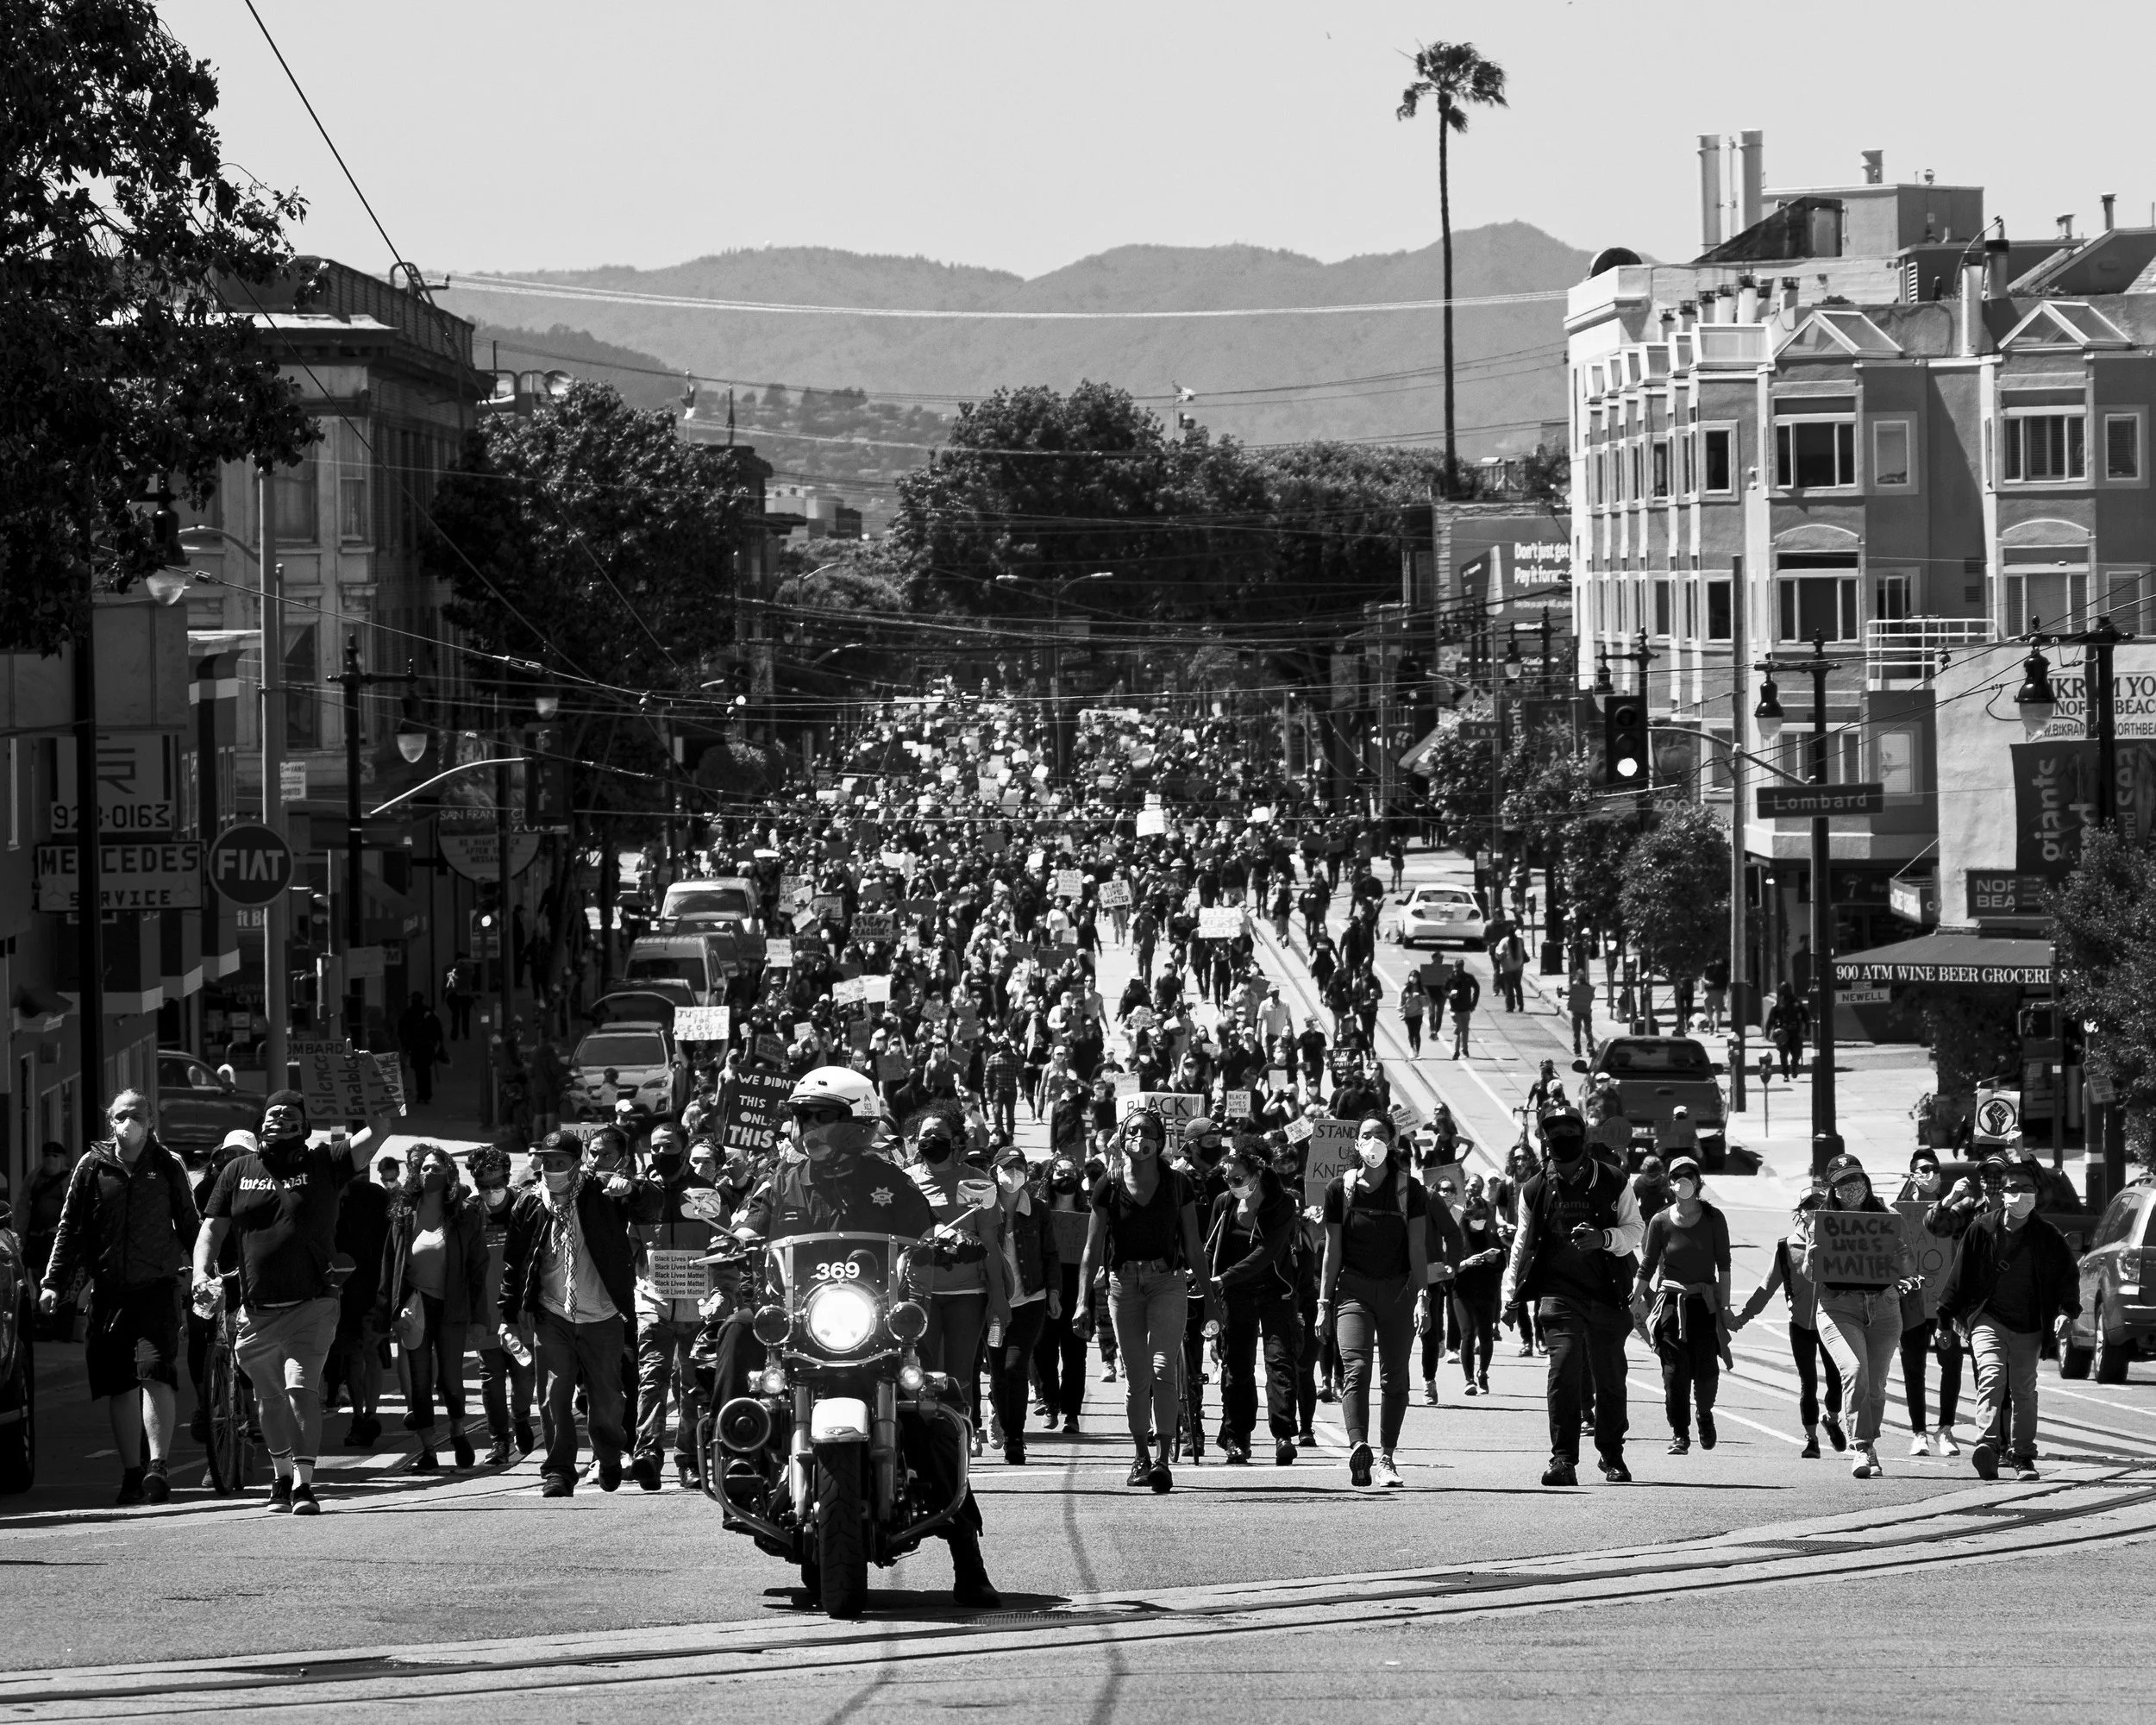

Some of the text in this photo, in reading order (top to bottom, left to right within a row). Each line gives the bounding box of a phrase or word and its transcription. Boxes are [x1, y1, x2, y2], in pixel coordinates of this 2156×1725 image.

[1773, 793, 1867, 811] Lombard
[440, 809, 463, 820] SAN
[41, 846, 197, 875] MECEDES
[217, 850, 285, 881] FIAT
[69, 890, 171, 907] SRVICE
[1977, 894, 2016, 908] BEA
[855, 916, 892, 929] FIGHT
[1836, 965, 1858, 980] 900
[1861, 965, 1893, 980] ATM
[1897, 966, 1935, 982] WINE
[1939, 967, 1978, 982] BEER
[1842, 992, 1883, 1002] NEWELL
[286, 1043, 344, 1054] OMBARD
[737, 1072, 761, 1086] WE
[738, 1095, 767, 1109] THIS
[729, 1124, 775, 1149] THIS
[1824, 1216, 1895, 1237] BLACK
[1831, 1237, 1883, 1252] LIVES
[816, 1261, 861, 1281] 369
[1822, 1254, 1899, 1279] MATTER
